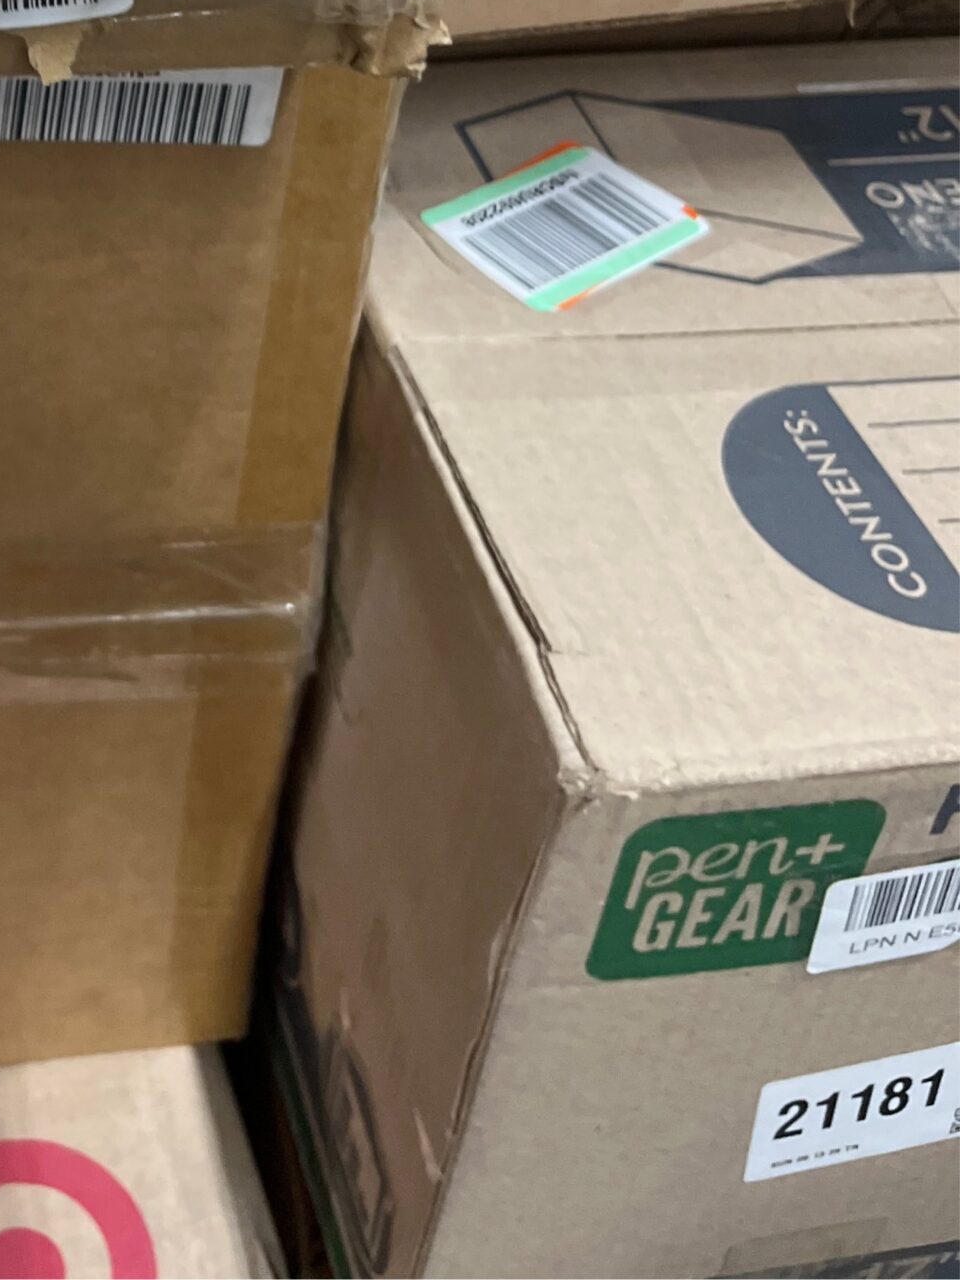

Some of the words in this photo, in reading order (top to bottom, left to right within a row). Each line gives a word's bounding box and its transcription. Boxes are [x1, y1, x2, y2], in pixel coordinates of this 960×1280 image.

[783, 408, 927, 600] CONTENTS:
[632, 877, 817, 953] GEAR
[849, 933, 897, 954] LPN
[903, 928, 922, 944] N
[773, 1067, 945, 1140] 21181
